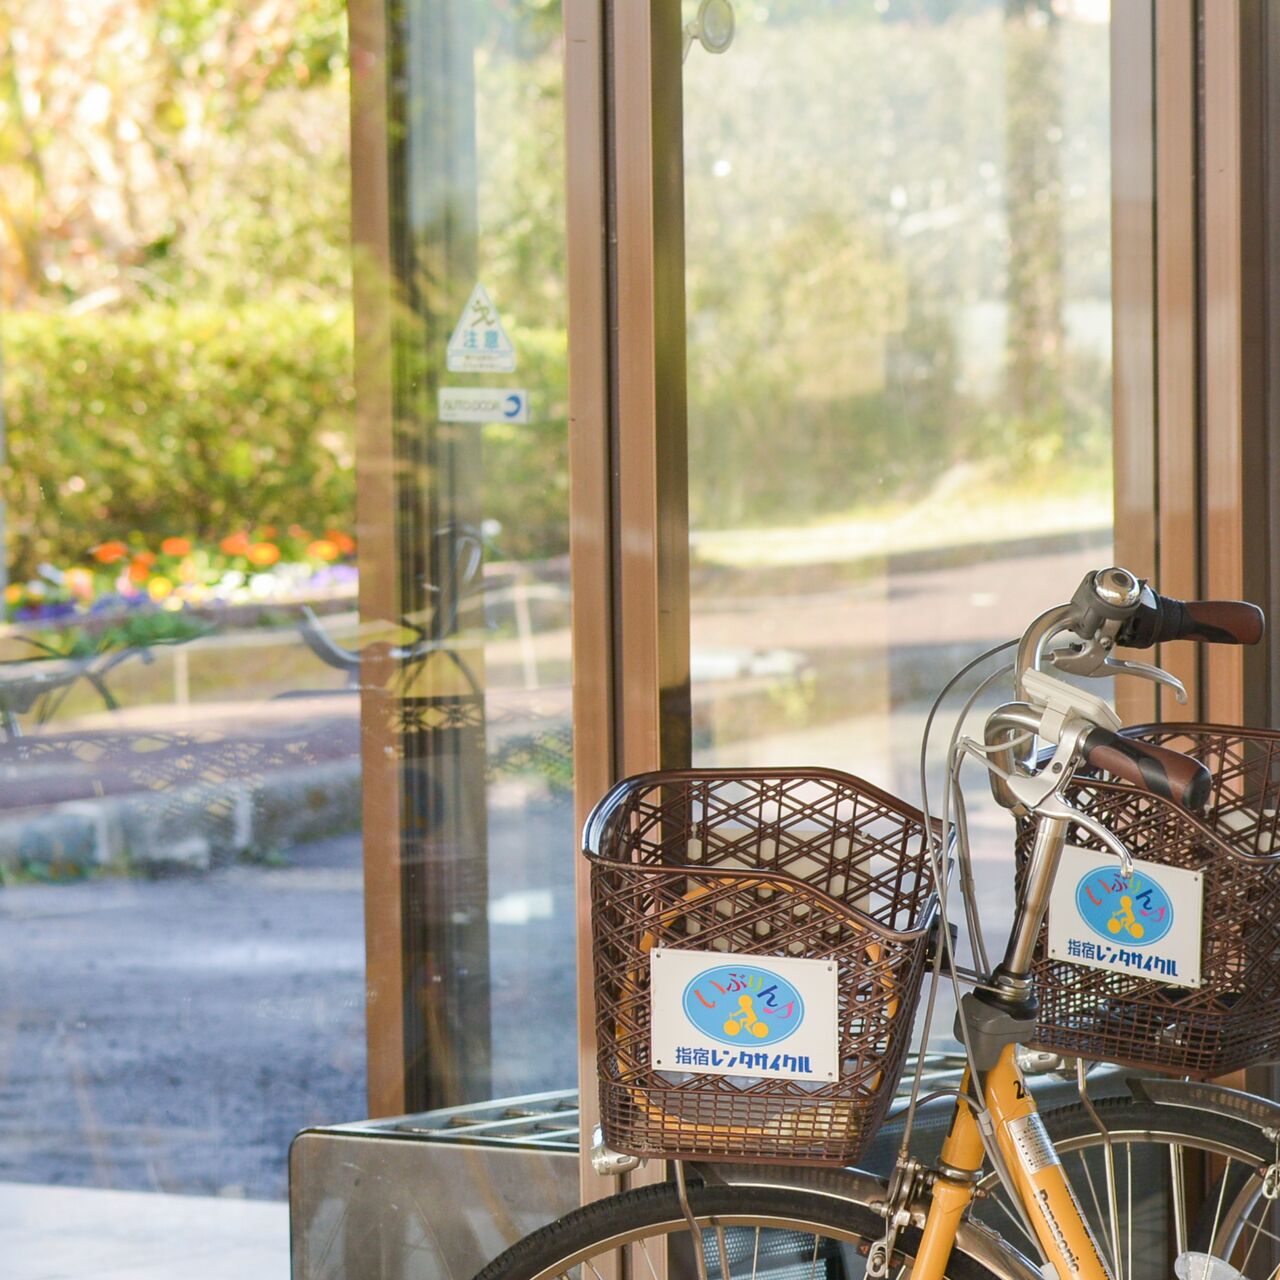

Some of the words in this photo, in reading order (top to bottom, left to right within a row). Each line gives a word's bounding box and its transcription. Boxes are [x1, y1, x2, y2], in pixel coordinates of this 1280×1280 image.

[1085, 872, 1154, 911] いぶりん
[1067, 937, 1179, 978] 指宿レンタサイクル
[694, 972, 780, 1010] いぶりん
[675, 1046, 813, 1074] 指宿レンタサイクル
[1036, 1188, 1080, 1274] Panasonic
